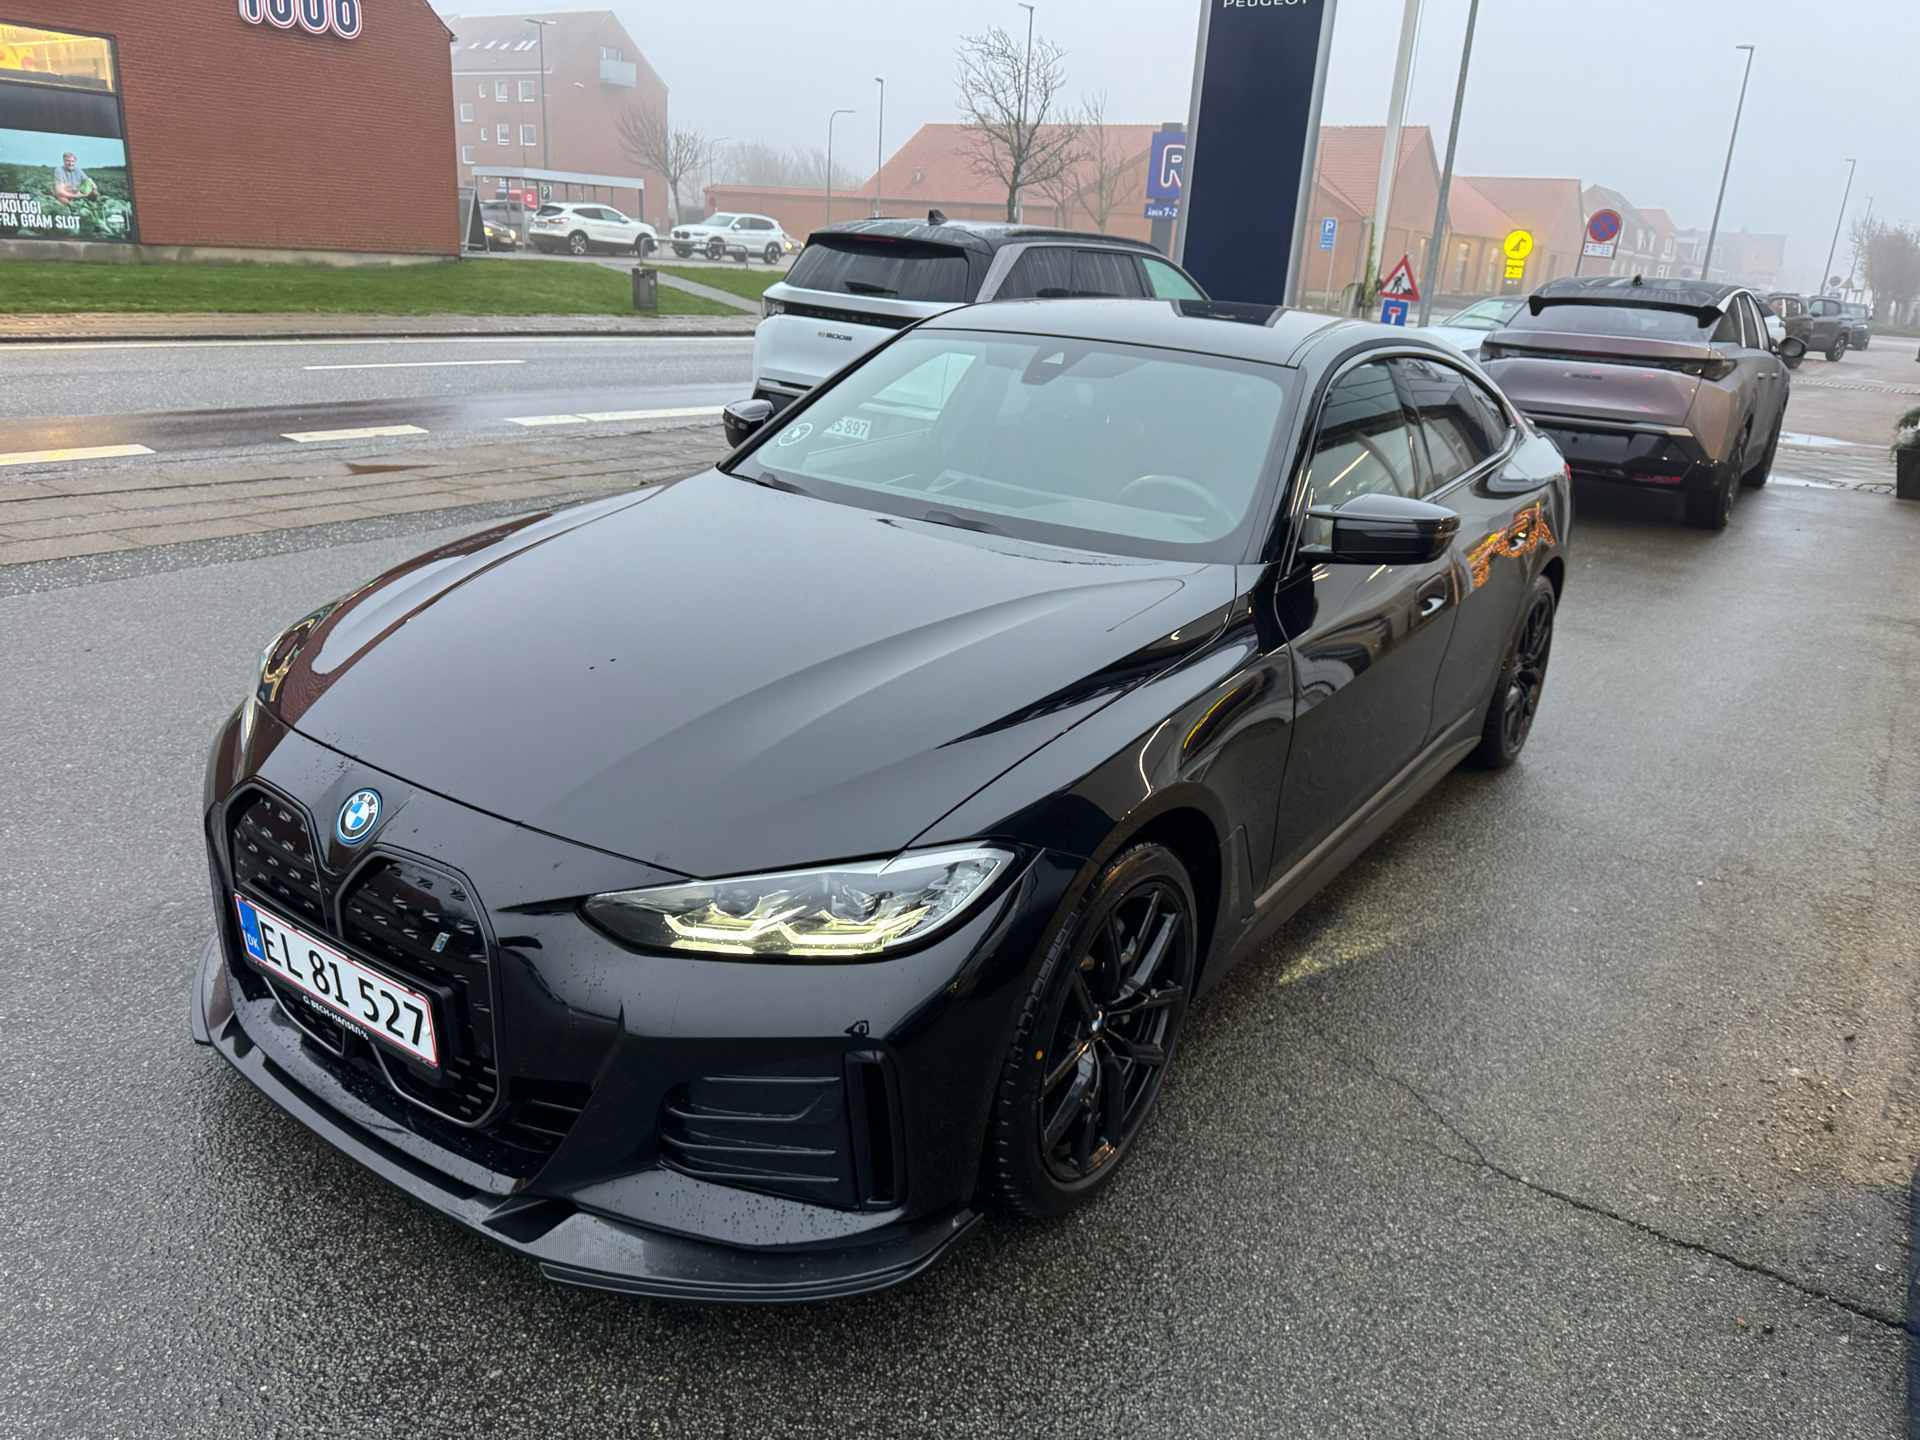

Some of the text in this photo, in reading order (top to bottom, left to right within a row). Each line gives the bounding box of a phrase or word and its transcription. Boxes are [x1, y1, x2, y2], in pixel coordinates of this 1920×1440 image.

[0, 199, 42, 214] KOLOGI
[20, 213, 53, 229] GRAM
[55, 215, 81, 229] SLOT
[1325, 221, 1334, 233] P
[844, 419, 868, 437] 897
[353, 794, 377, 814] BMW
[247, 933, 260, 950] DK
[260, 920, 424, 1046] EL 81 527
